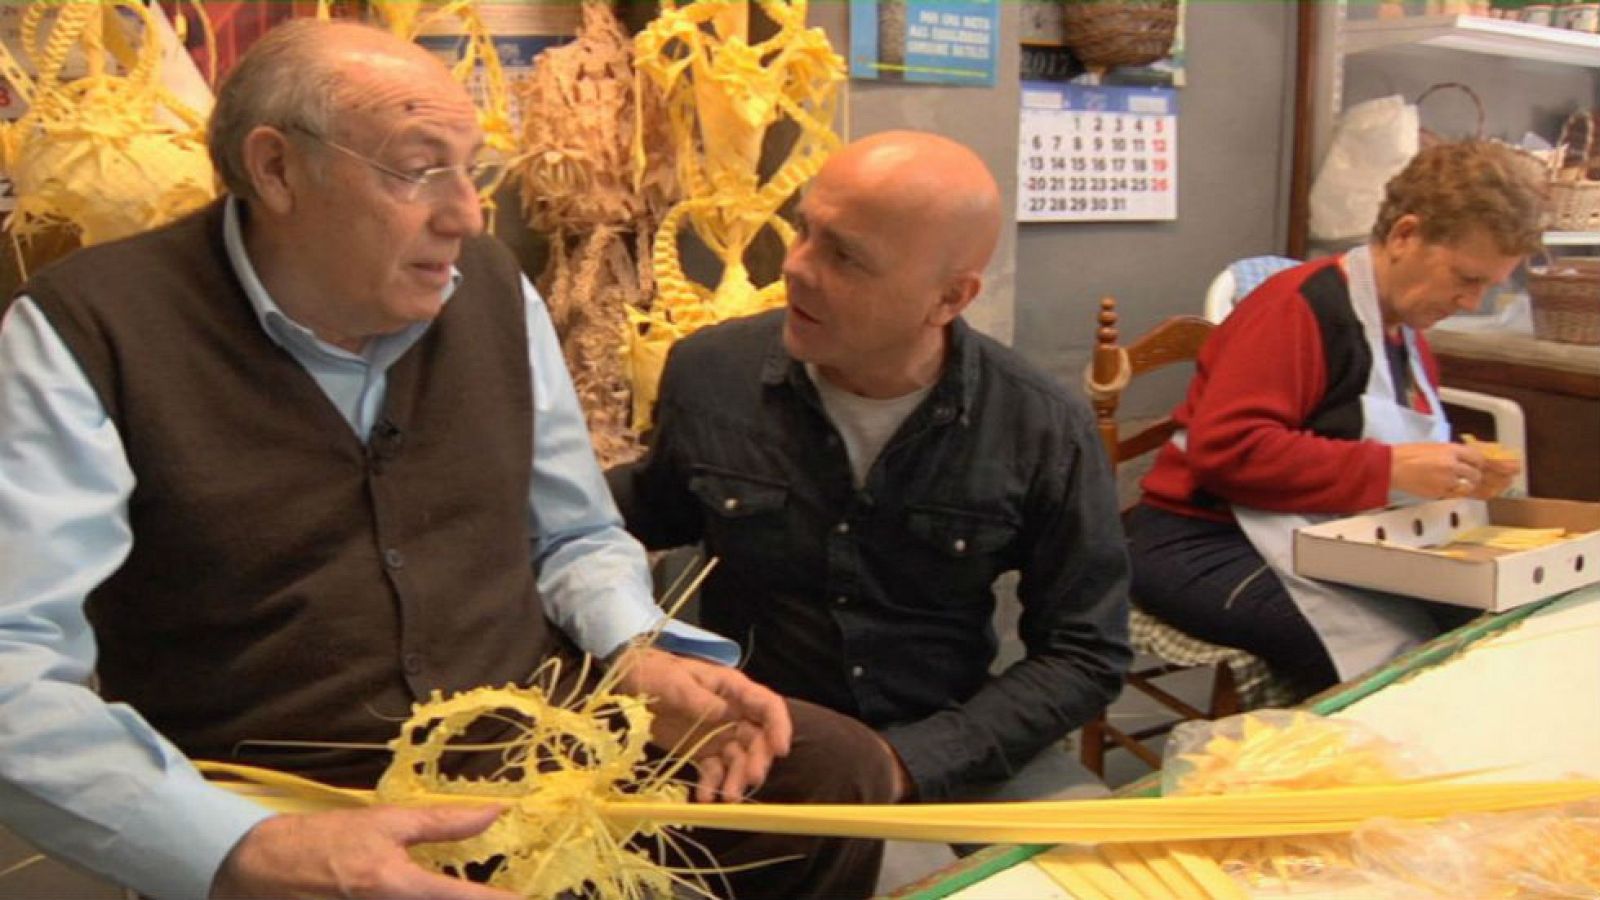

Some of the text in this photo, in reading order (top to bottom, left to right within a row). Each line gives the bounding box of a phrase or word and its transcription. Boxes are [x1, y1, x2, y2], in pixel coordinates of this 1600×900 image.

[1022, 50, 1070, 75] 2017
[1073, 117, 1164, 134] 1 2 3 4 5
[1031, 135, 1167, 153] 6 7 8 9 10 11 12
[1029, 156, 1167, 173] 13 14 15 16 17 18 19
[1028, 176, 1168, 193] 20 21 22 23 24 25 26
[1029, 197, 1126, 212] 27 28 29 30 31
